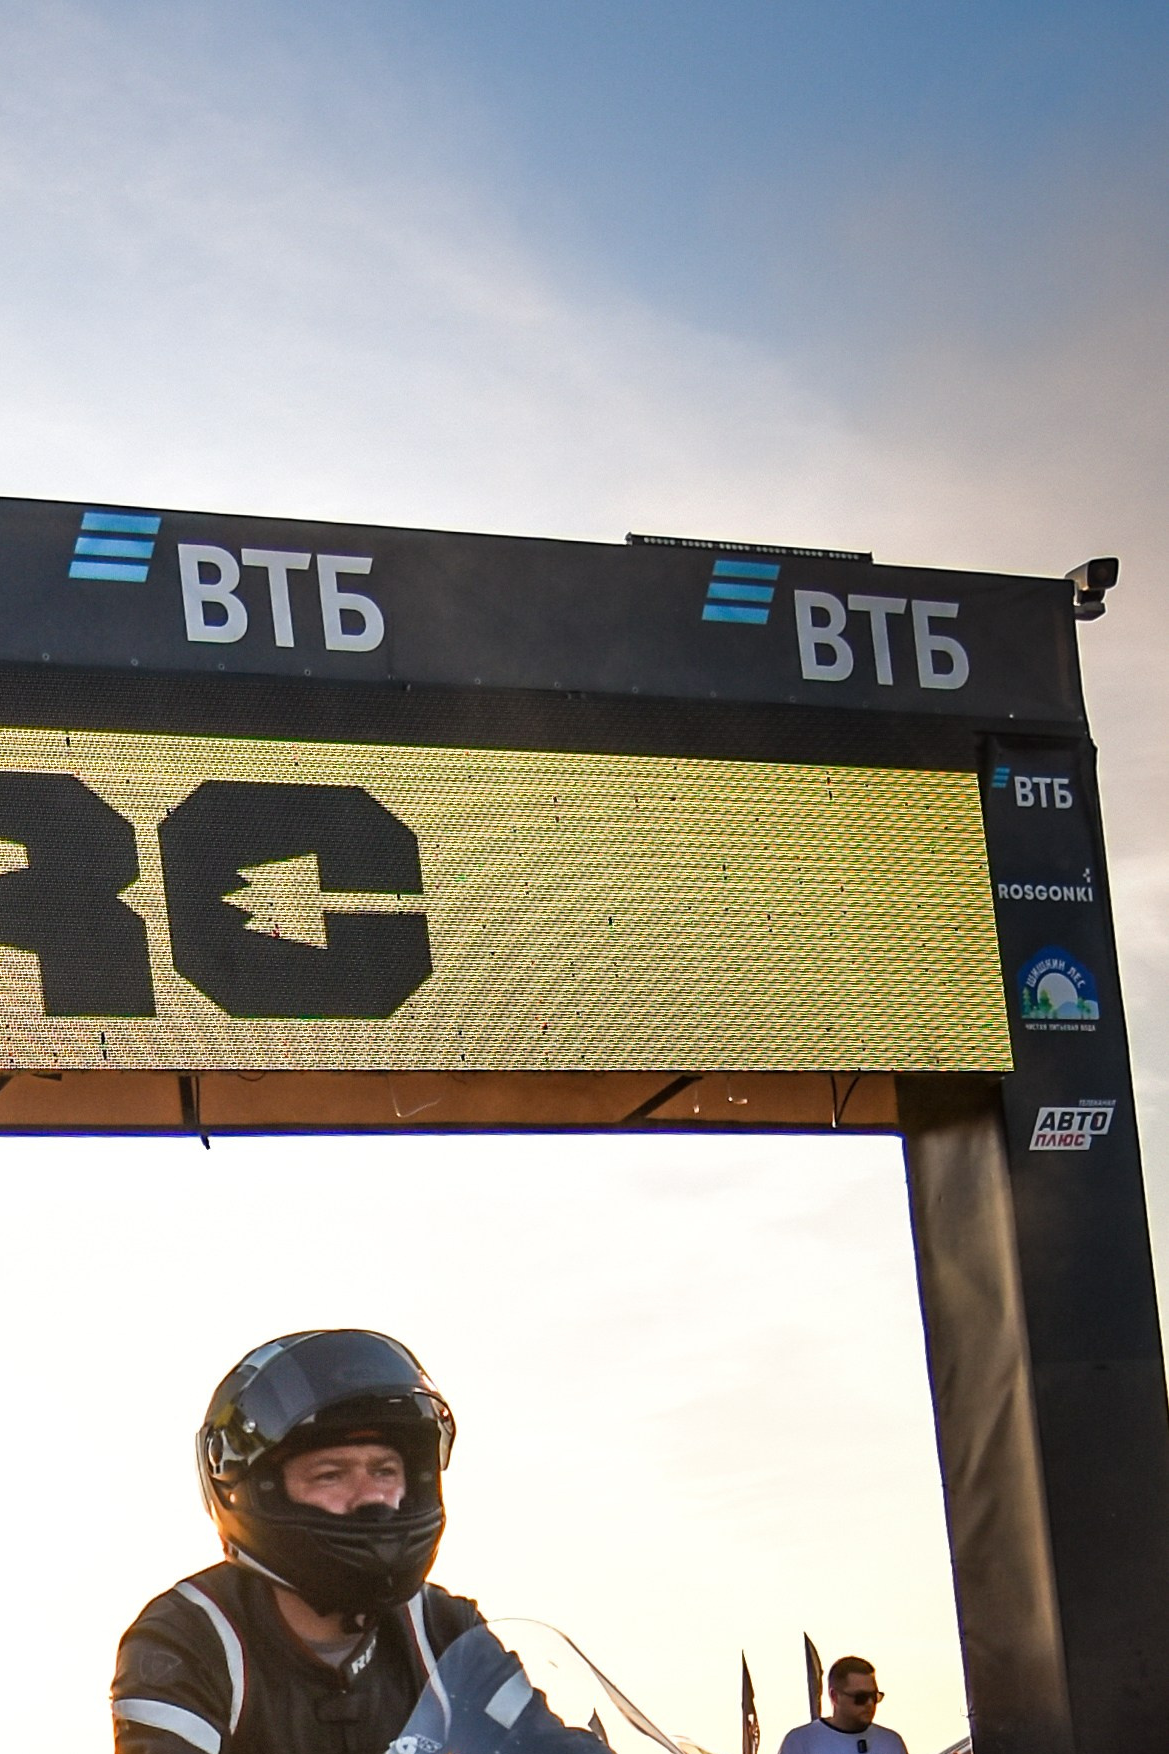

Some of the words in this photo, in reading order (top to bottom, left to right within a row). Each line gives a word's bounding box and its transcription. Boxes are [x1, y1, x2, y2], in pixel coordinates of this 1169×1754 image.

[177, 543, 385, 653] ВТБ
[793, 589, 970, 691] ВТБ
[1014, 776, 1073, 809] ВТБ
[997, 883, 1094, 902] ROSGONKI
[1026, 958, 1066, 988] ШИШКИН
[1066, 966, 1086, 988] ЛЕС
[1038, 1111, 1108, 1131] АВТО
[1034, 1133, 1085, 1147] ПЛЮС
